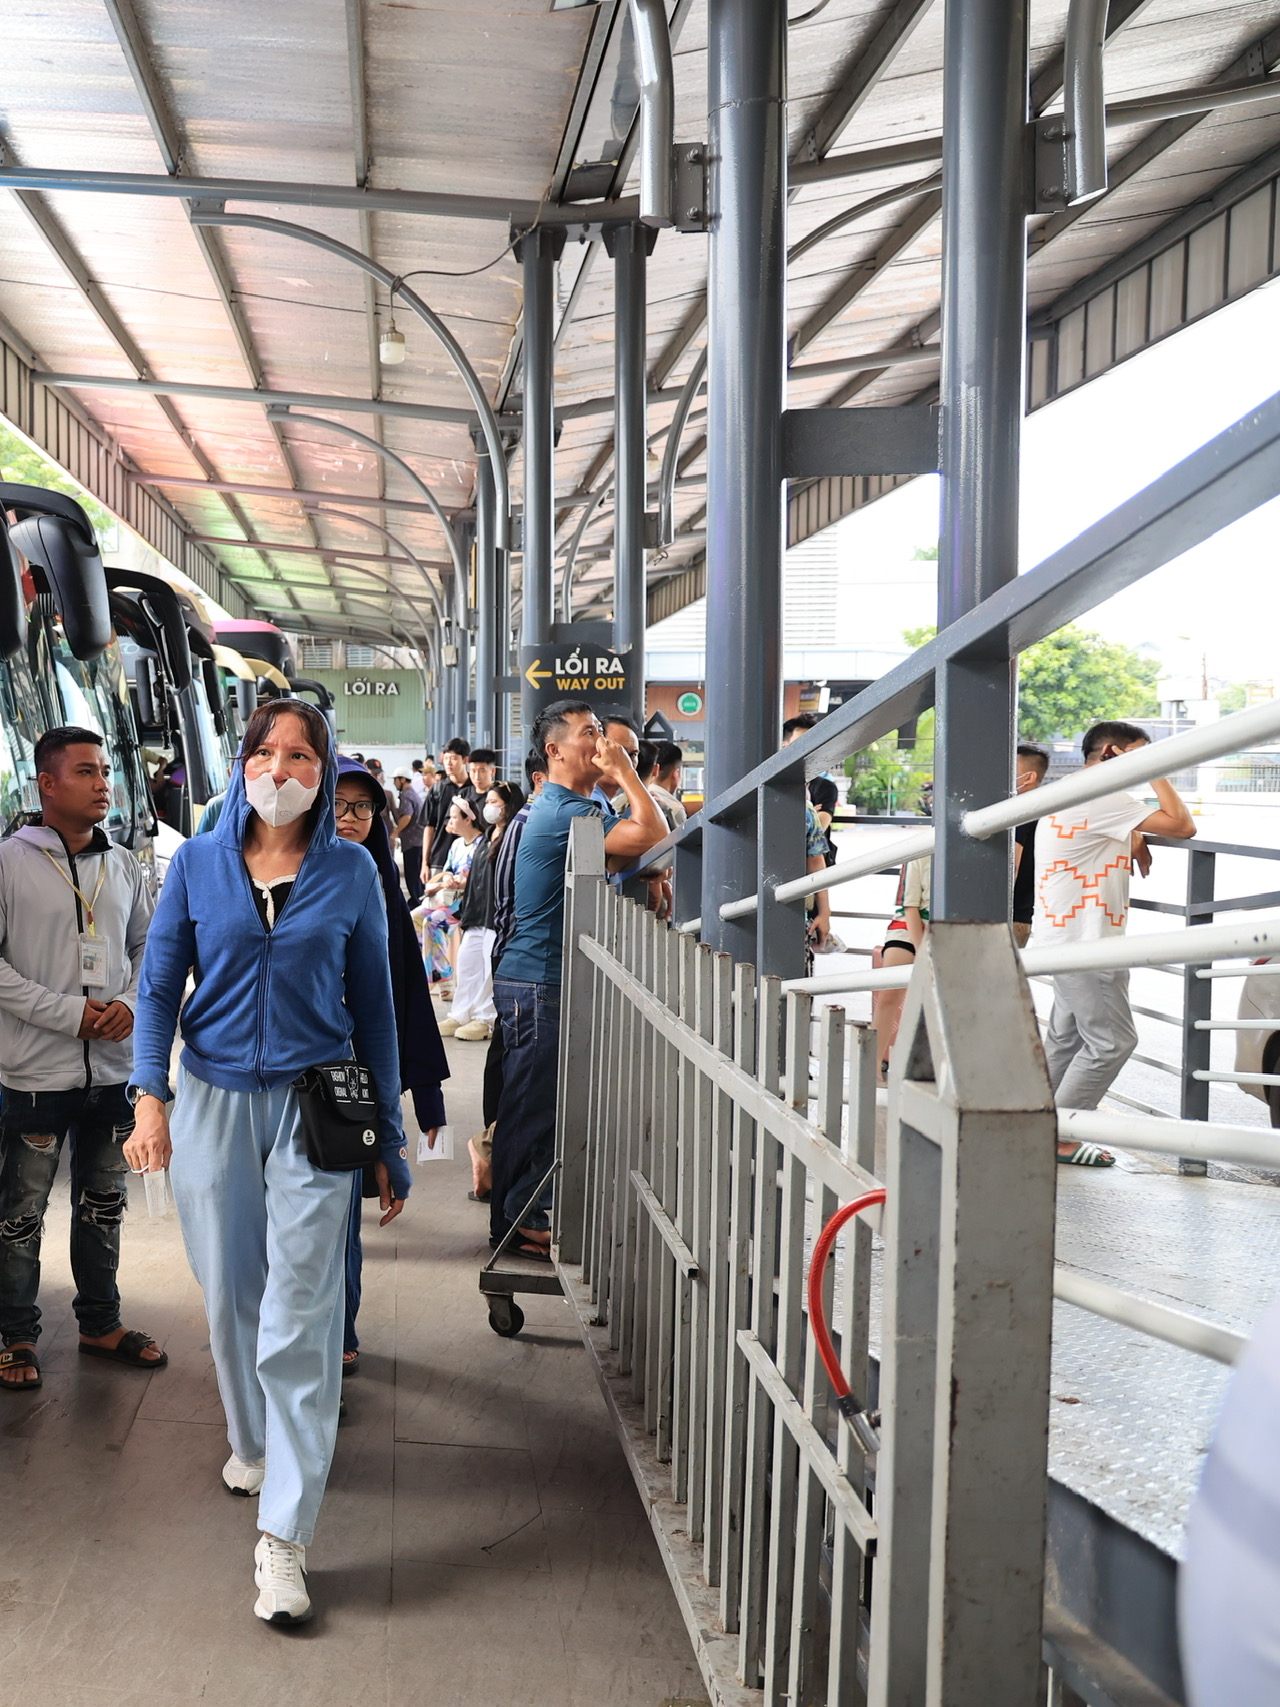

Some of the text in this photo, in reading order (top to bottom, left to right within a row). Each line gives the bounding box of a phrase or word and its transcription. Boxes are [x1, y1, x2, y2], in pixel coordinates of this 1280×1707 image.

[596, 657, 625, 674] RA
[344, 677, 399, 695] LỐI RA
[556, 677, 626, 690] WAY OUT
